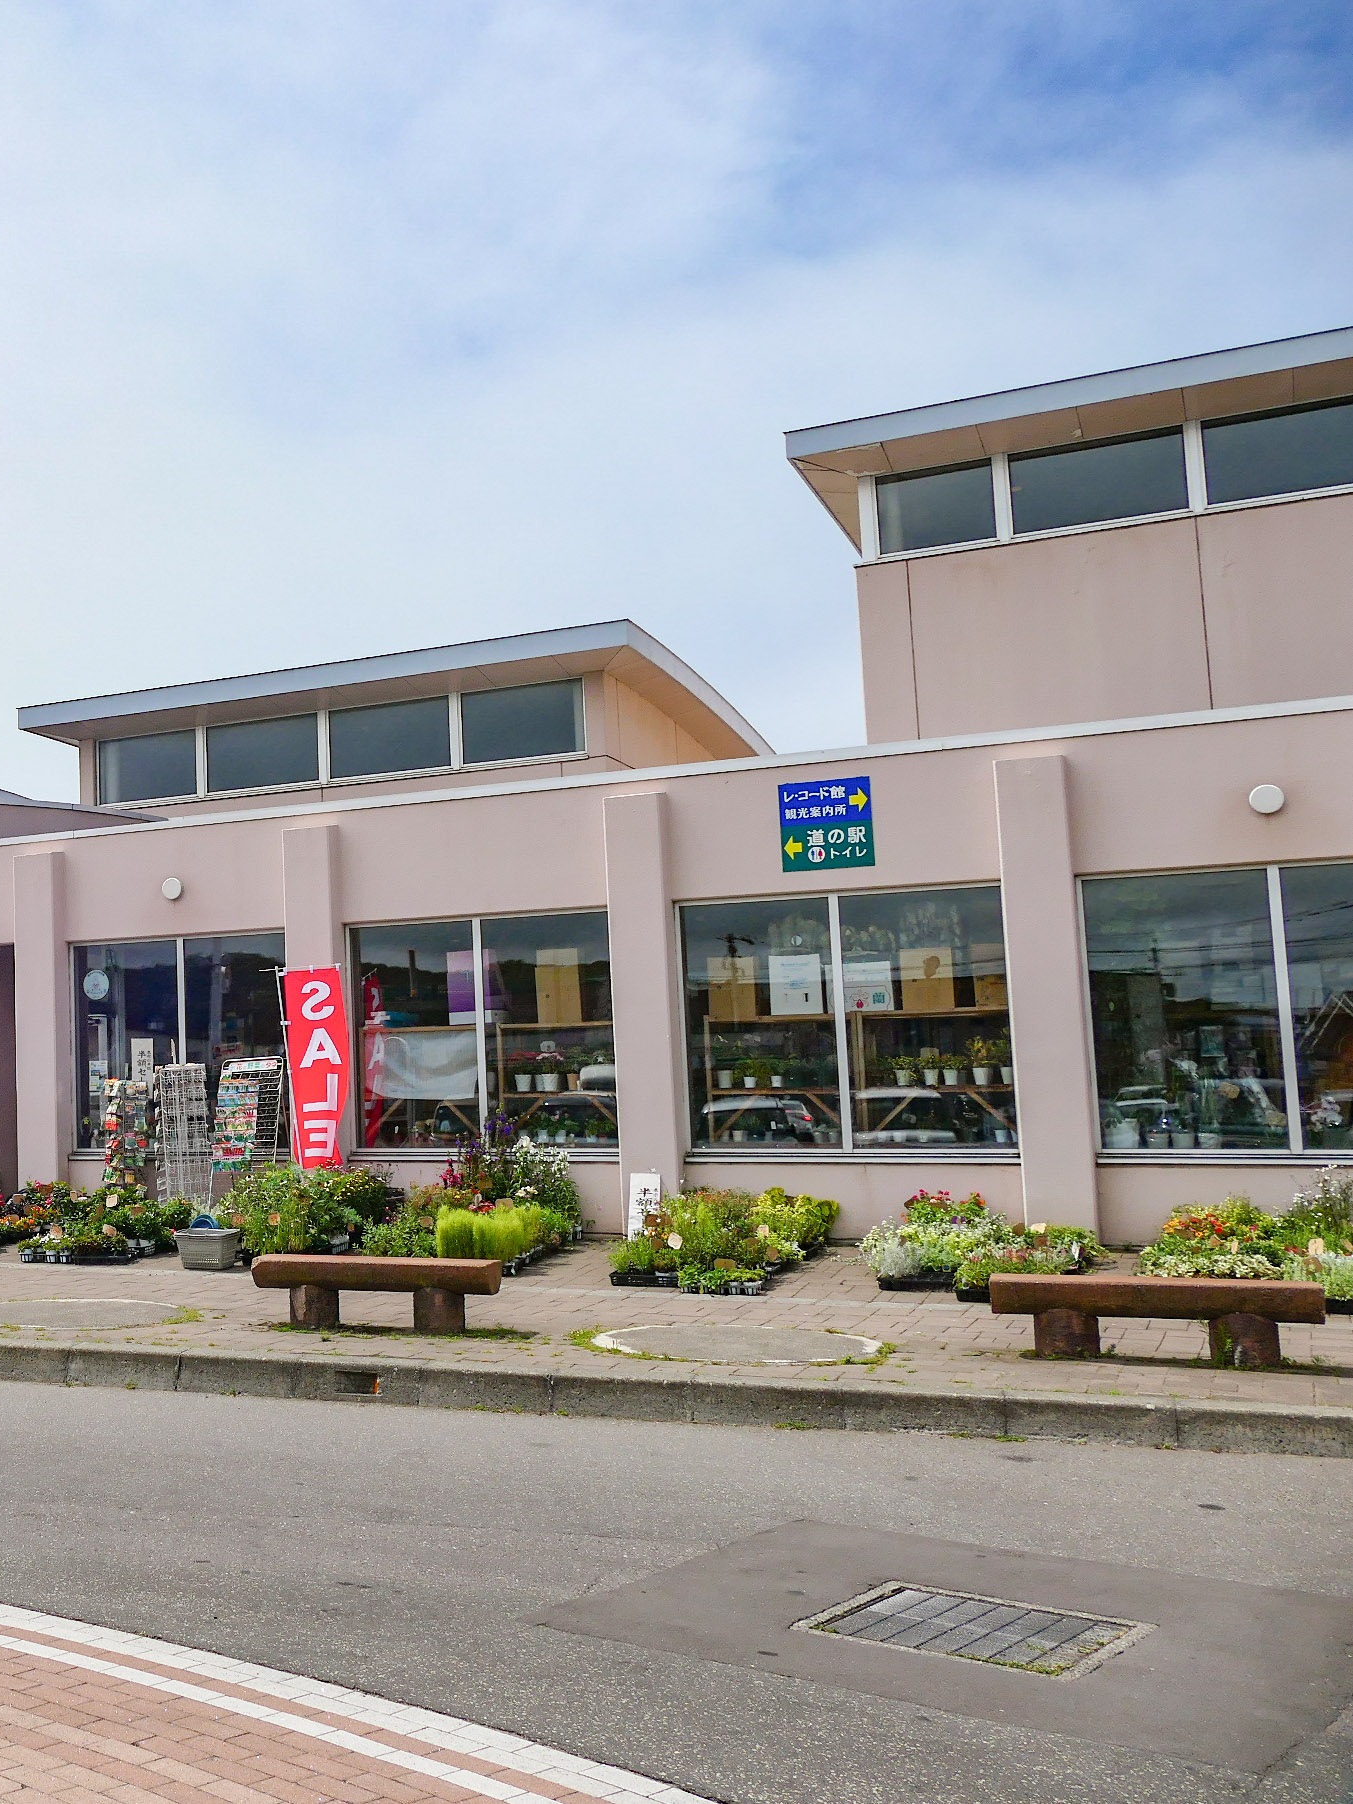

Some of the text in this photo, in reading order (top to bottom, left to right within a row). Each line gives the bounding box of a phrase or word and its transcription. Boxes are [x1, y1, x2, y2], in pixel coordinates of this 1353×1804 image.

[784, 803, 847, 820] 観光案内所
[806, 826, 867, 847] 道の駅
[830, 846, 867, 859] トイレ
